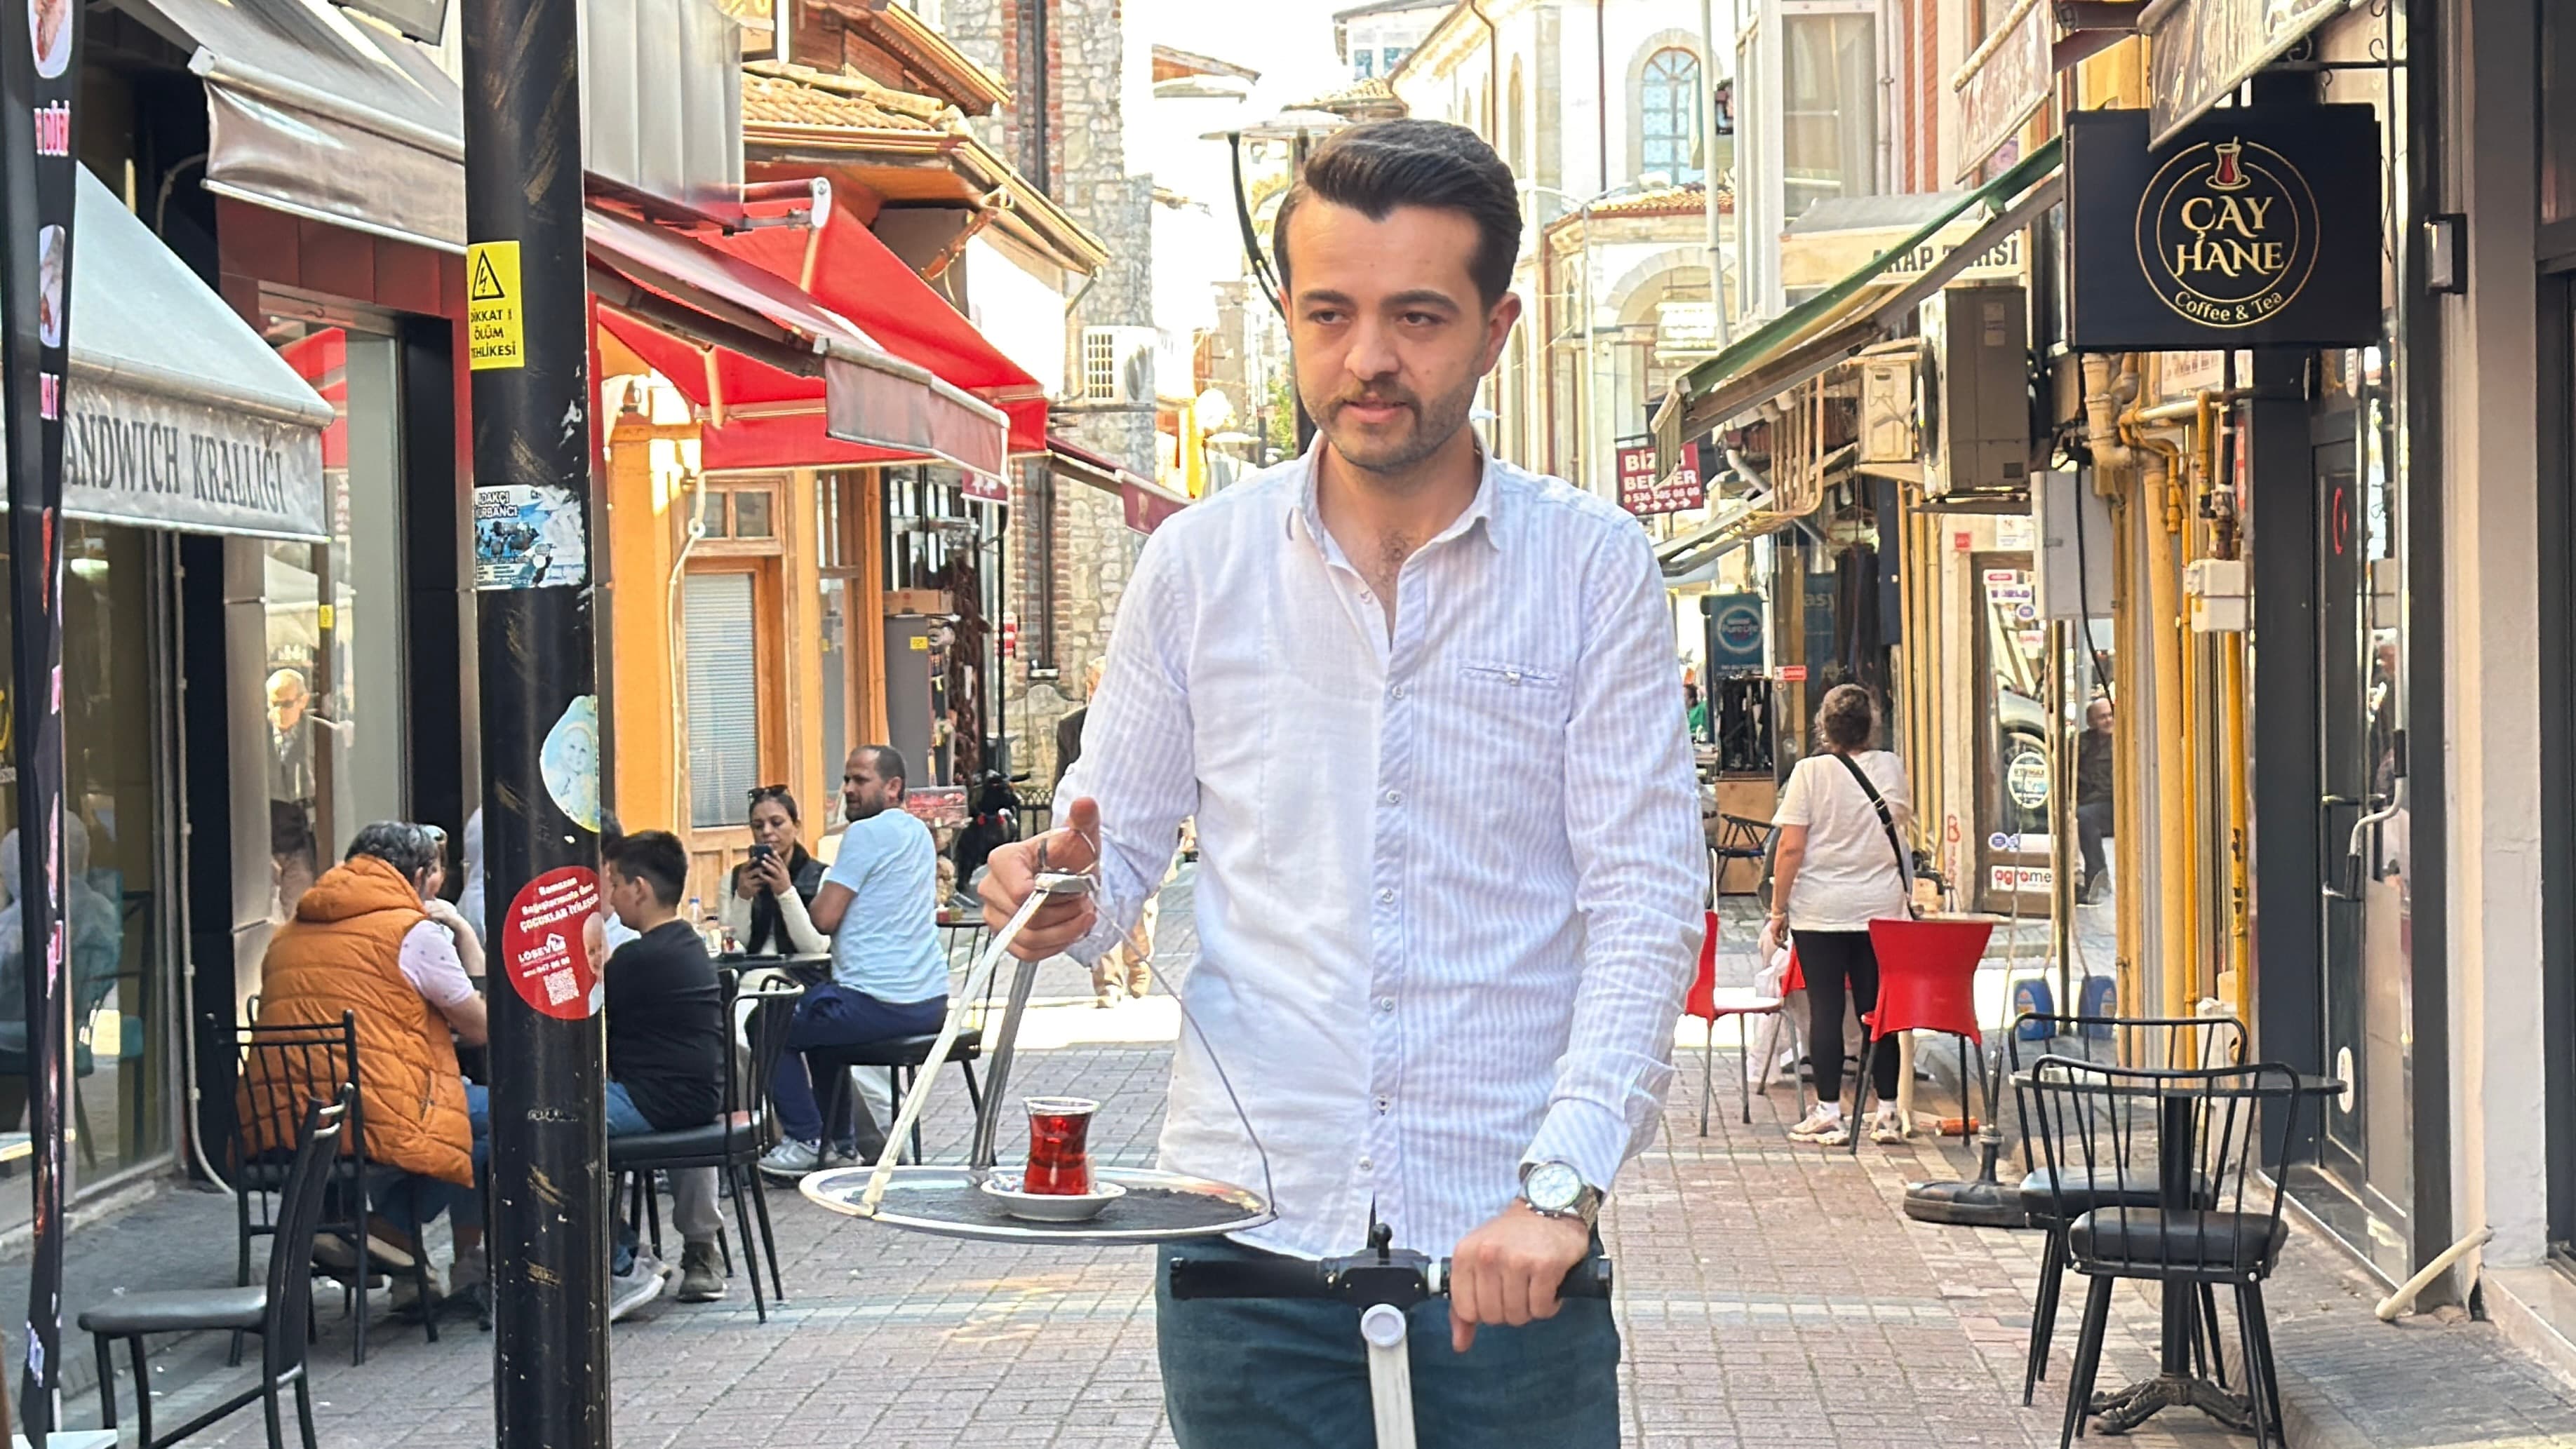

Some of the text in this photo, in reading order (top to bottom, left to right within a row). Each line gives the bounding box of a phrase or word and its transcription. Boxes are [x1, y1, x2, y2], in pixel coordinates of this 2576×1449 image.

[2181, 195, 2273, 239] ÇAY
[2175, 238, 2284, 277] HANE
[2175, 291, 2283, 321] Coffee & Tea
[474, 323, 504, 341] ÖLÜM
